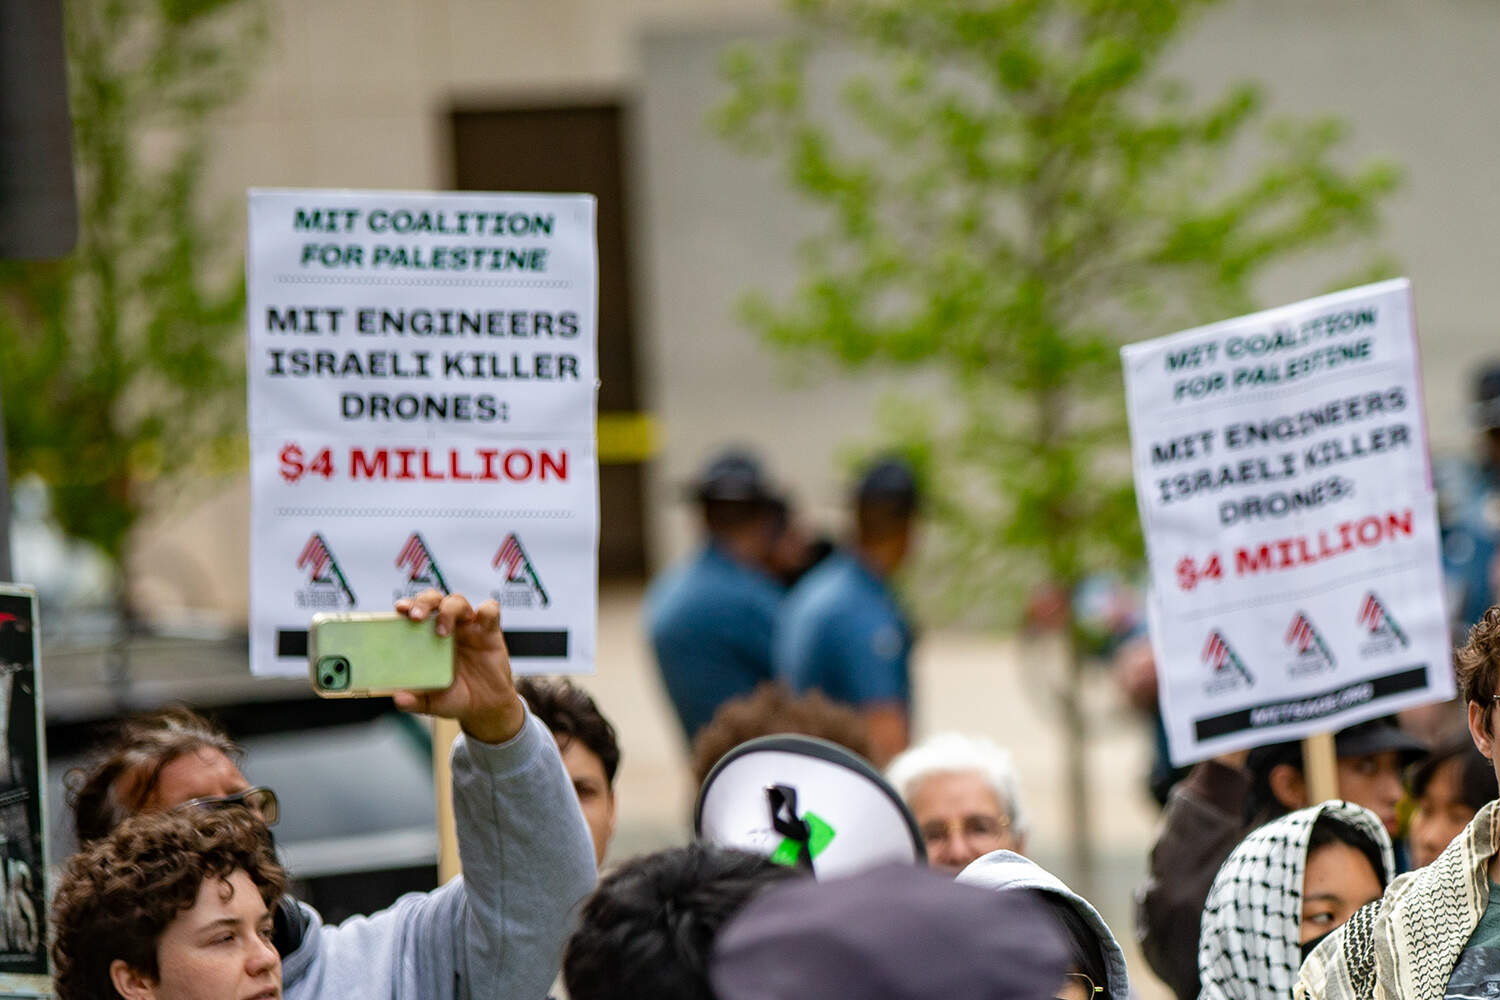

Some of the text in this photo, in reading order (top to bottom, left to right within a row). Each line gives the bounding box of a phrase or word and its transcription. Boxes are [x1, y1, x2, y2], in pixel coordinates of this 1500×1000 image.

[293, 208, 555, 236] MIT COALITION
[300, 243, 549, 272] FOR PALESTINE
[265, 307, 581, 338] MIT ENGINEERS
[1165, 306, 1378, 372] MIT COALITION
[267, 349, 580, 381] ISRAELI KILLER
[1173, 337, 1372, 400] FOR PALESTINE
[339, 392, 510, 423] DRONES:
[1151, 385, 1407, 466] MIT ENGINEERS
[277, 442, 569, 485] $4 MILLION
[1157, 423, 1412, 503] ISRAELI KILLER
[1175, 507, 1415, 592] $4 MILLION
